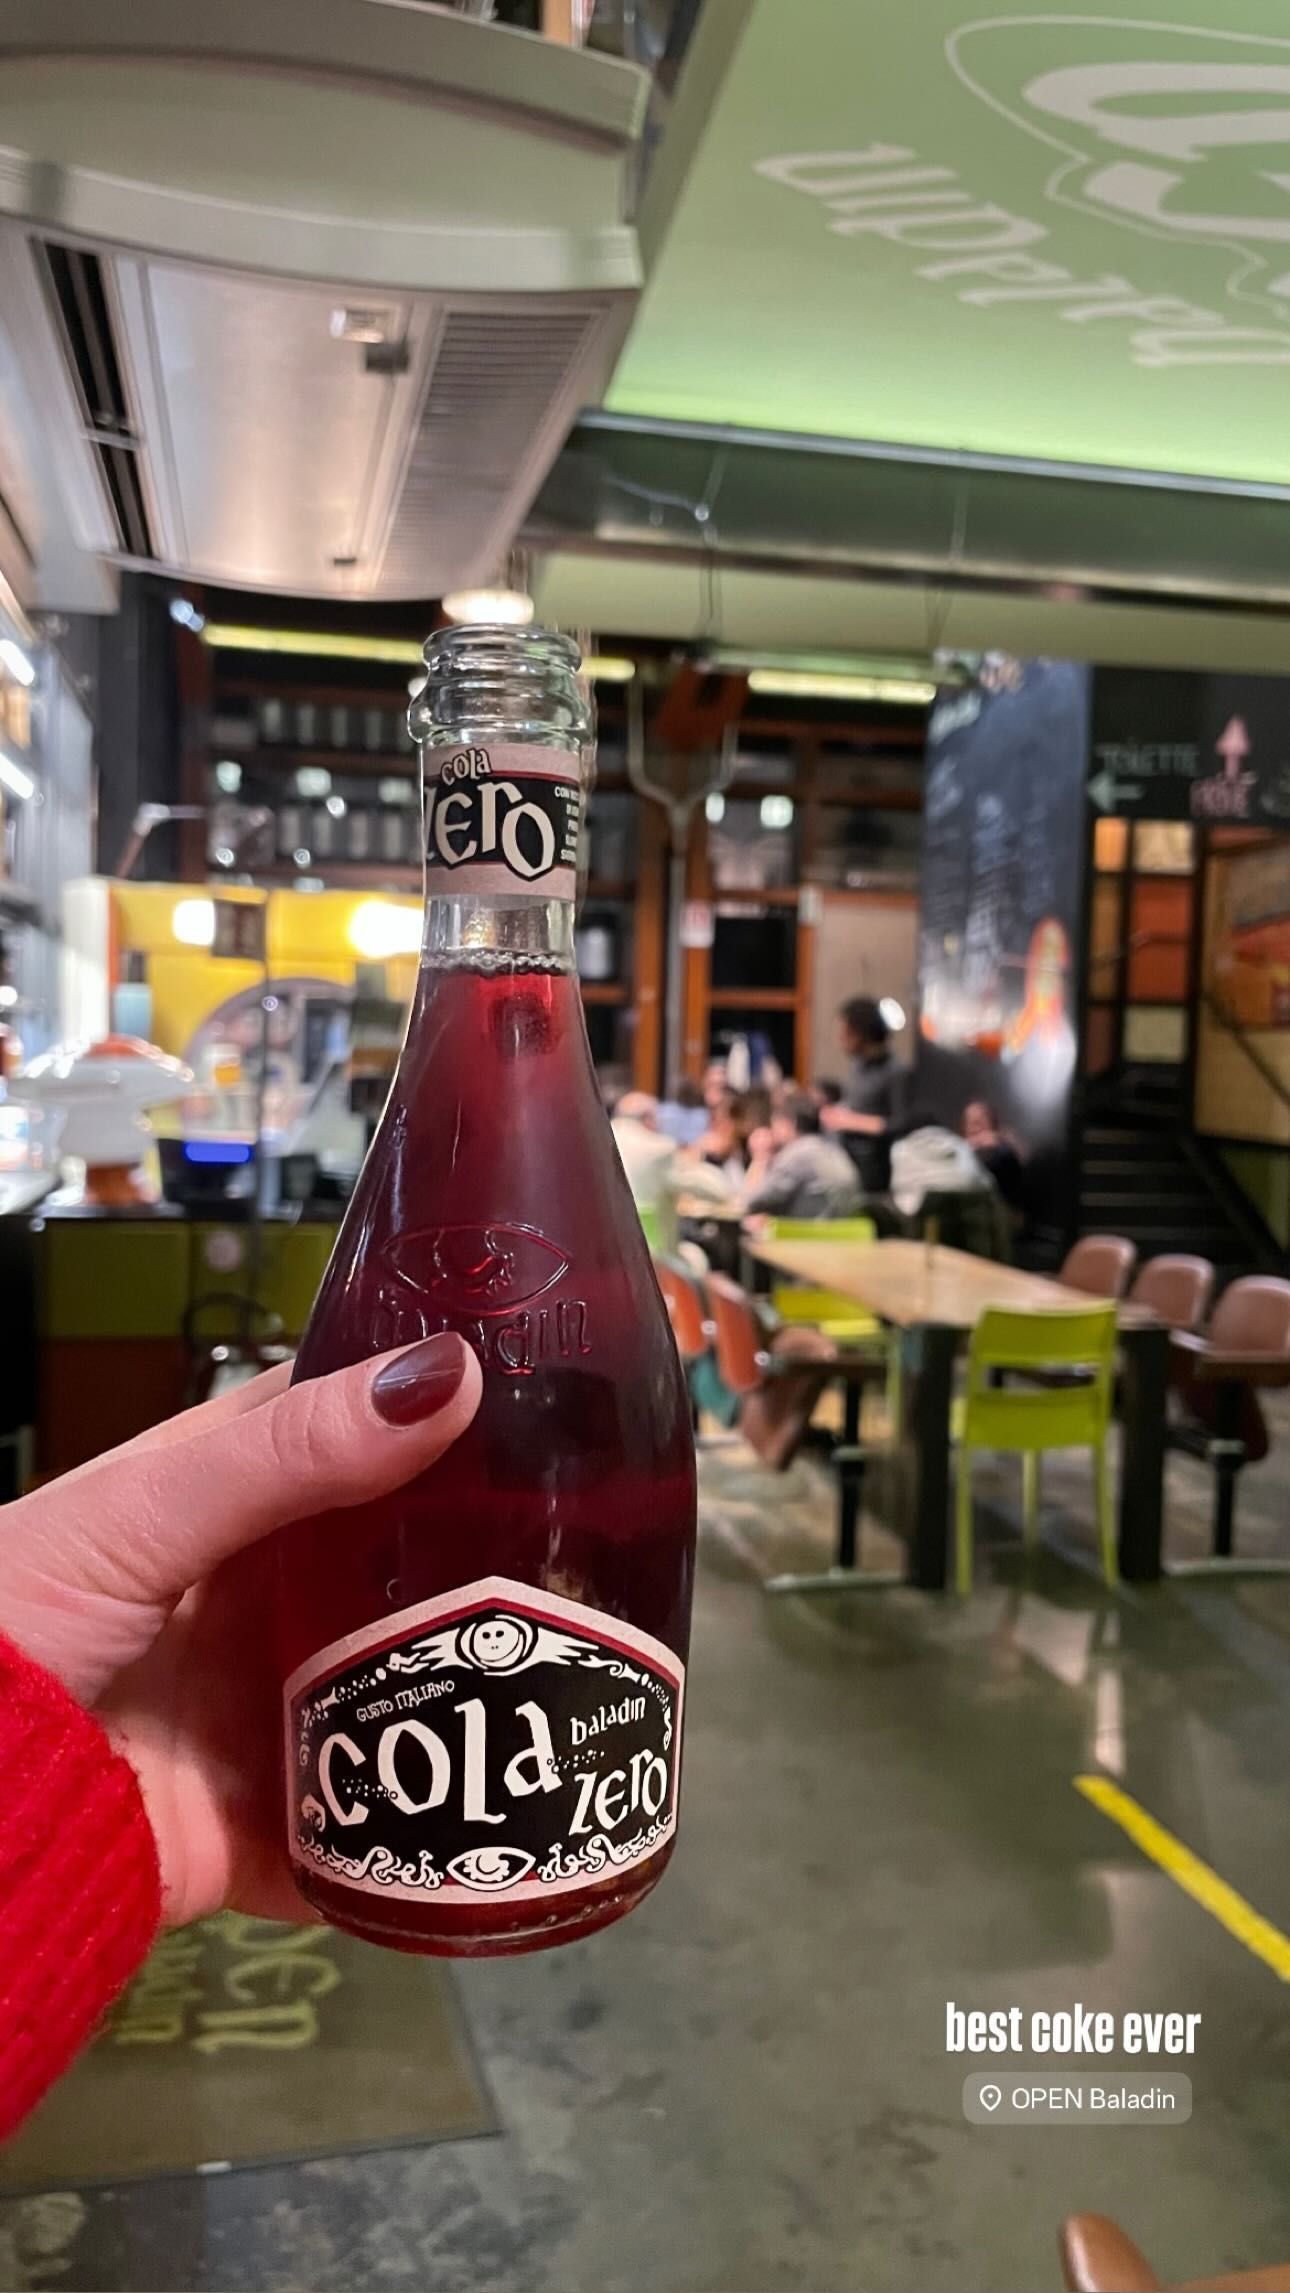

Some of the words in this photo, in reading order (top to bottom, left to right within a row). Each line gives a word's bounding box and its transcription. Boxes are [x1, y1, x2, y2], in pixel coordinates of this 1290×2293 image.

[441, 748, 491, 786] cola
[356, 1700, 394, 1722] GUSTO
[395, 1679, 455, 1710] ITALIANO
[571, 1696, 646, 1746] baladin
[318, 1698, 562, 1827] cola
[568, 1747, 668, 1837] zero
